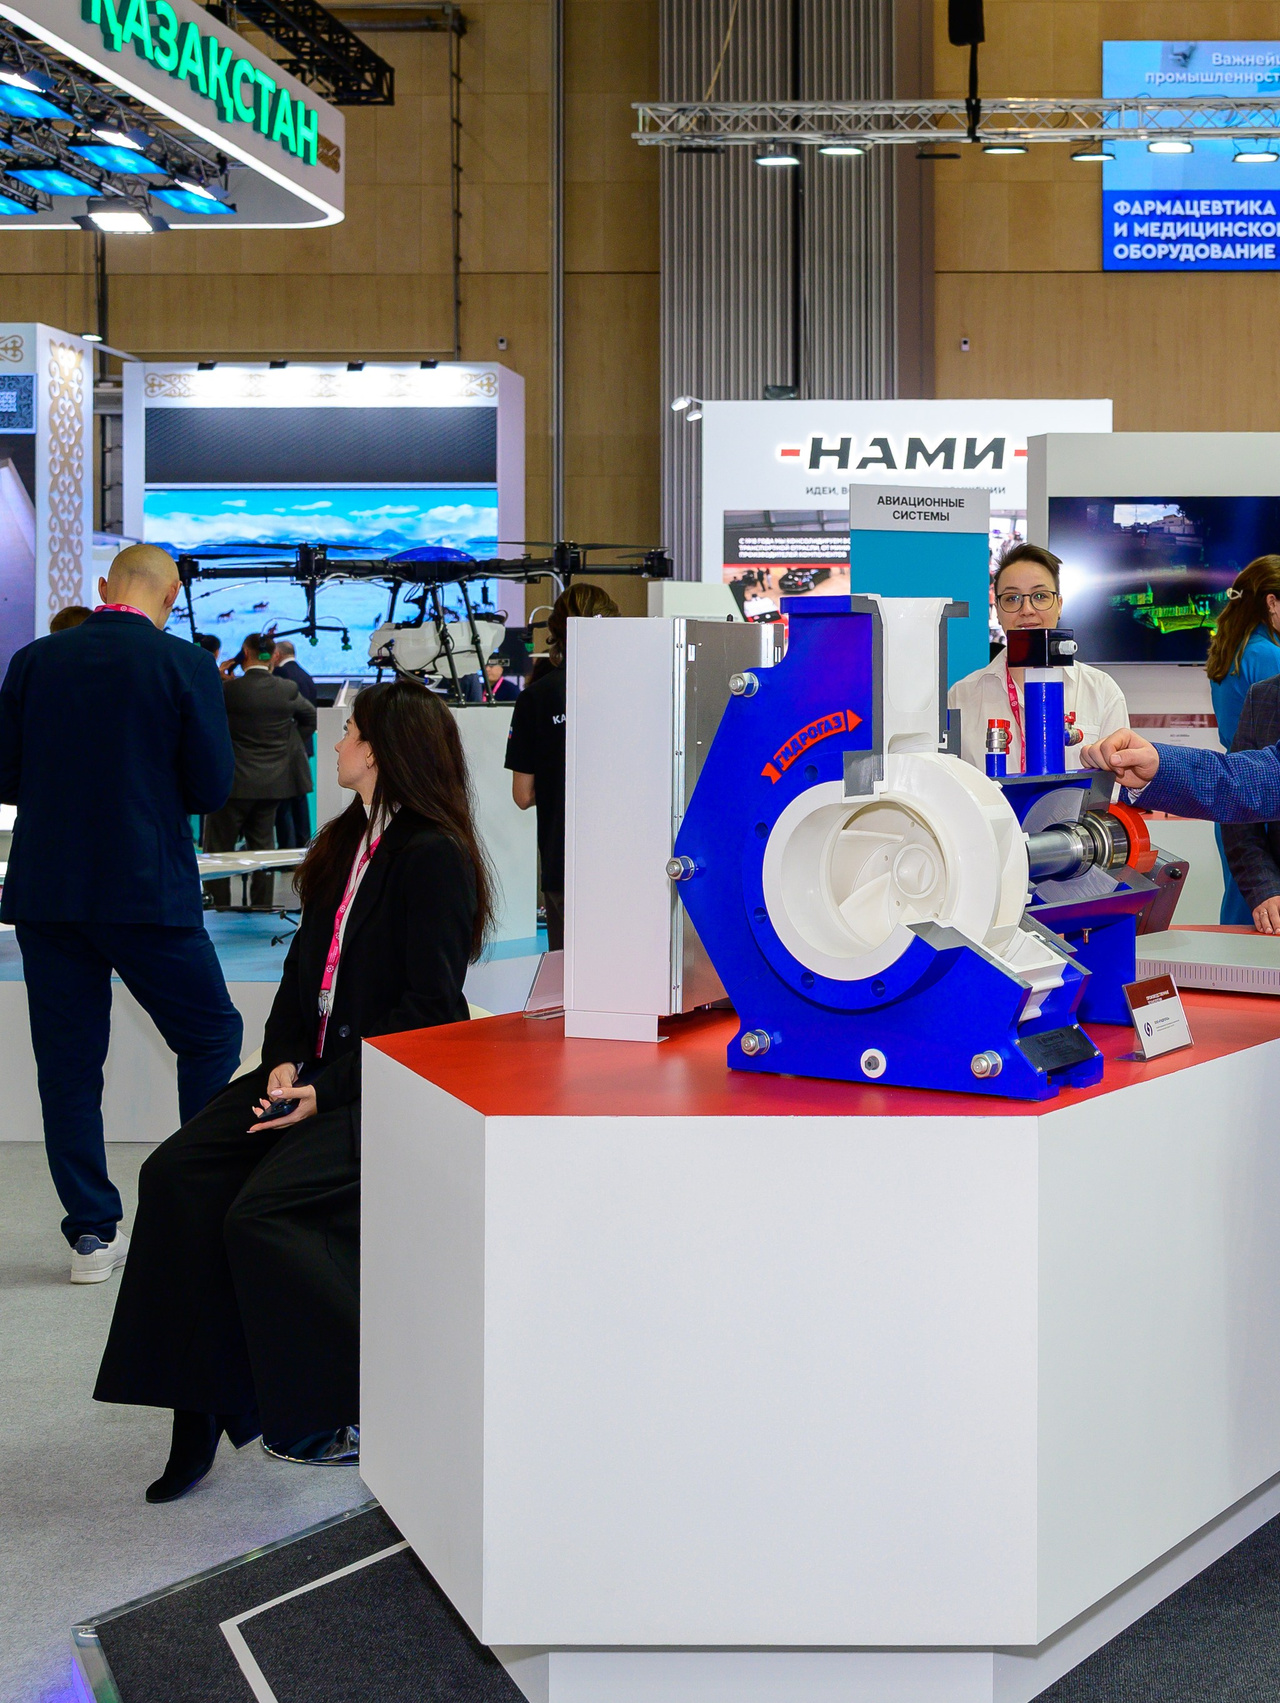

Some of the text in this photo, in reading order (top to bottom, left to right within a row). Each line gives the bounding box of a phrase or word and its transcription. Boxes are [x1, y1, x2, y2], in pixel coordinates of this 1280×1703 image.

[1113, 199, 1277, 217] ФАРМАЦЕВТИКА
[1114, 222, 1129, 238] И
[1113, 243, 1276, 261] ОБОРУДОВАНИЕ
[808, 437, 1006, 470] НАМИ
[876, 495, 966, 509] АВИАЦИОННЫЕ
[892, 510, 950, 522] СИСТЕМЫ
[774, 715, 843, 768] ГИДРОГАЗ
